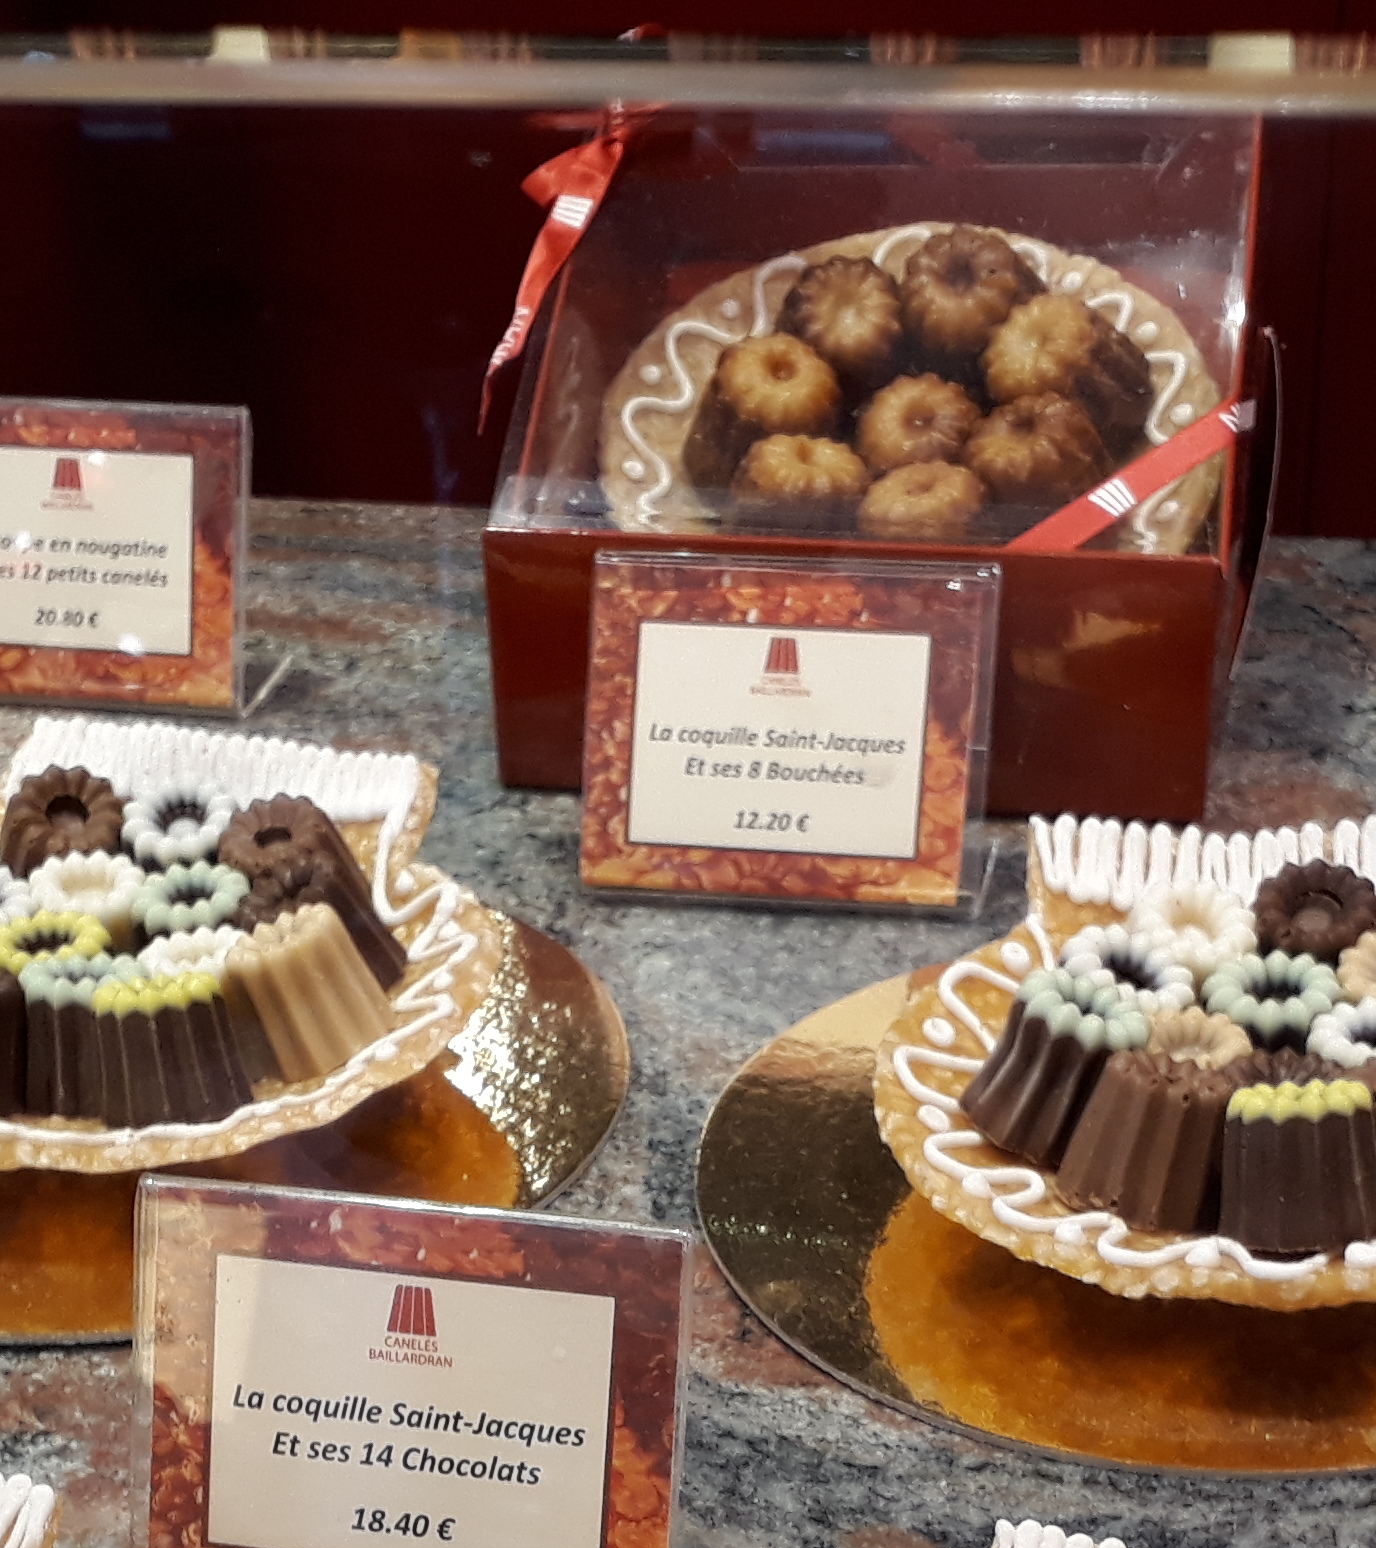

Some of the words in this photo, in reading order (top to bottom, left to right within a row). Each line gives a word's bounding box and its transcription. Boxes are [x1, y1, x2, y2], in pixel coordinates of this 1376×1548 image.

[49, 539, 72, 553] en
[648, 723, 674, 742] La
[677, 725, 760, 749] coquille
[763, 728, 907, 757] Saint-Jacques
[684, 756, 706, 777] Et
[709, 762, 743, 779] ses
[747, 760, 762, 779] 8
[765, 761, 867, 785] Bouchées
[733, 810, 793, 832] 12.20
[796, 813, 810, 833] €
[368, 1347, 453, 1368] BAILLARDRAN
[384, 1335, 439, 1353] CANELÉS
[232, 1384, 265, 1410] La
[272, 1394, 383, 1424] coquille
[389, 1402, 586, 1448] Saint-Jacques
[272, 1431, 301, 1458] Et
[306, 1441, 352, 1463] ses
[359, 1442, 394, 1468] 14
[402, 1447, 542, 1486] Chocolats
[351, 1508, 430, 1538] 18.40
[436, 1517, 457, 1541] €
